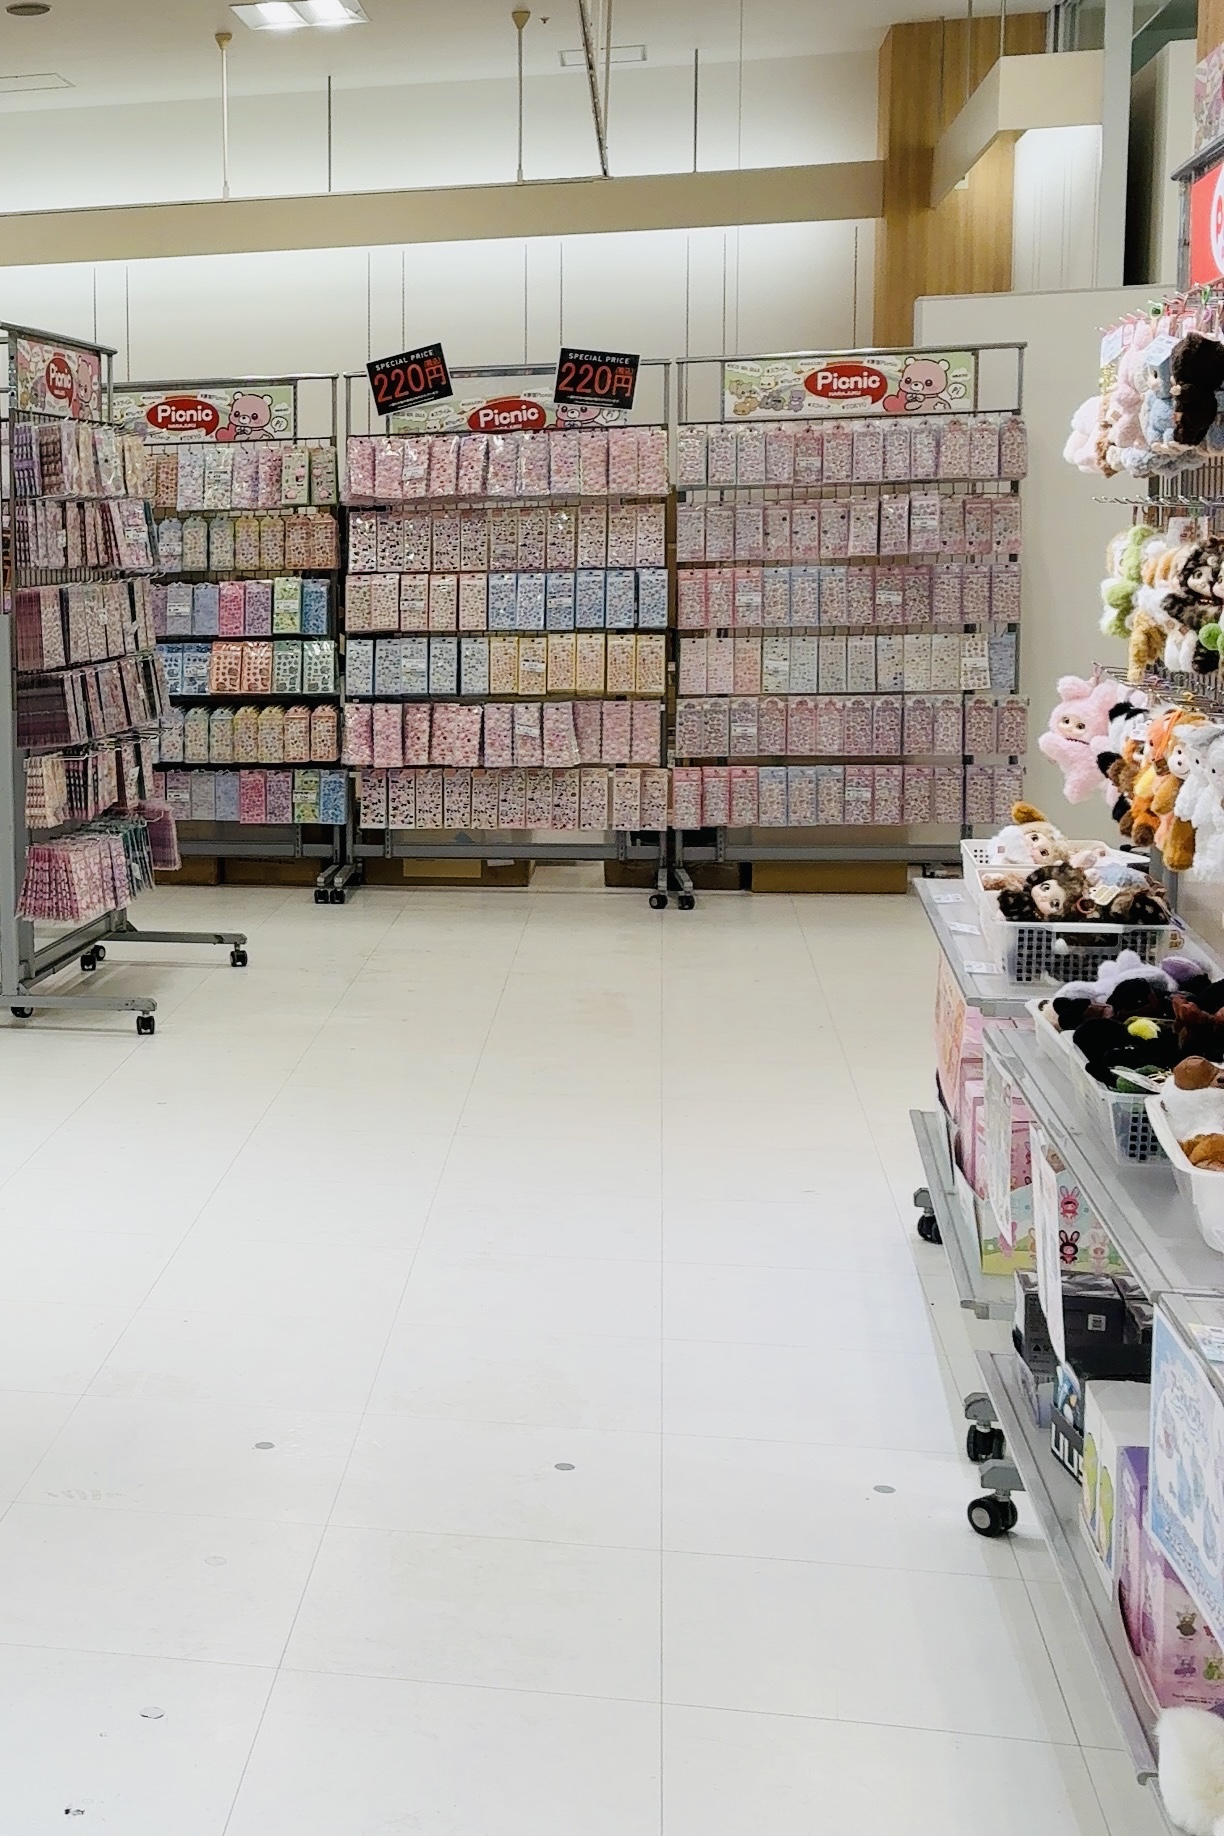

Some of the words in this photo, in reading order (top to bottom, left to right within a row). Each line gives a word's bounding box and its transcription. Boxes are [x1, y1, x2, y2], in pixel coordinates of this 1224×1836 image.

[375, 357, 409, 371] SPECIAL
[410, 349, 434, 361] PRICE
[568, 352, 603, 362] SPECIAL
[605, 356, 630, 365] PRICE
[374, 364, 446, 403] 220円
[558, 362, 633, 397] 220円
[816, 371, 881, 390] Picnic
[157, 404, 213, 423] Picnic
[479, 404, 539, 428] Picnic
